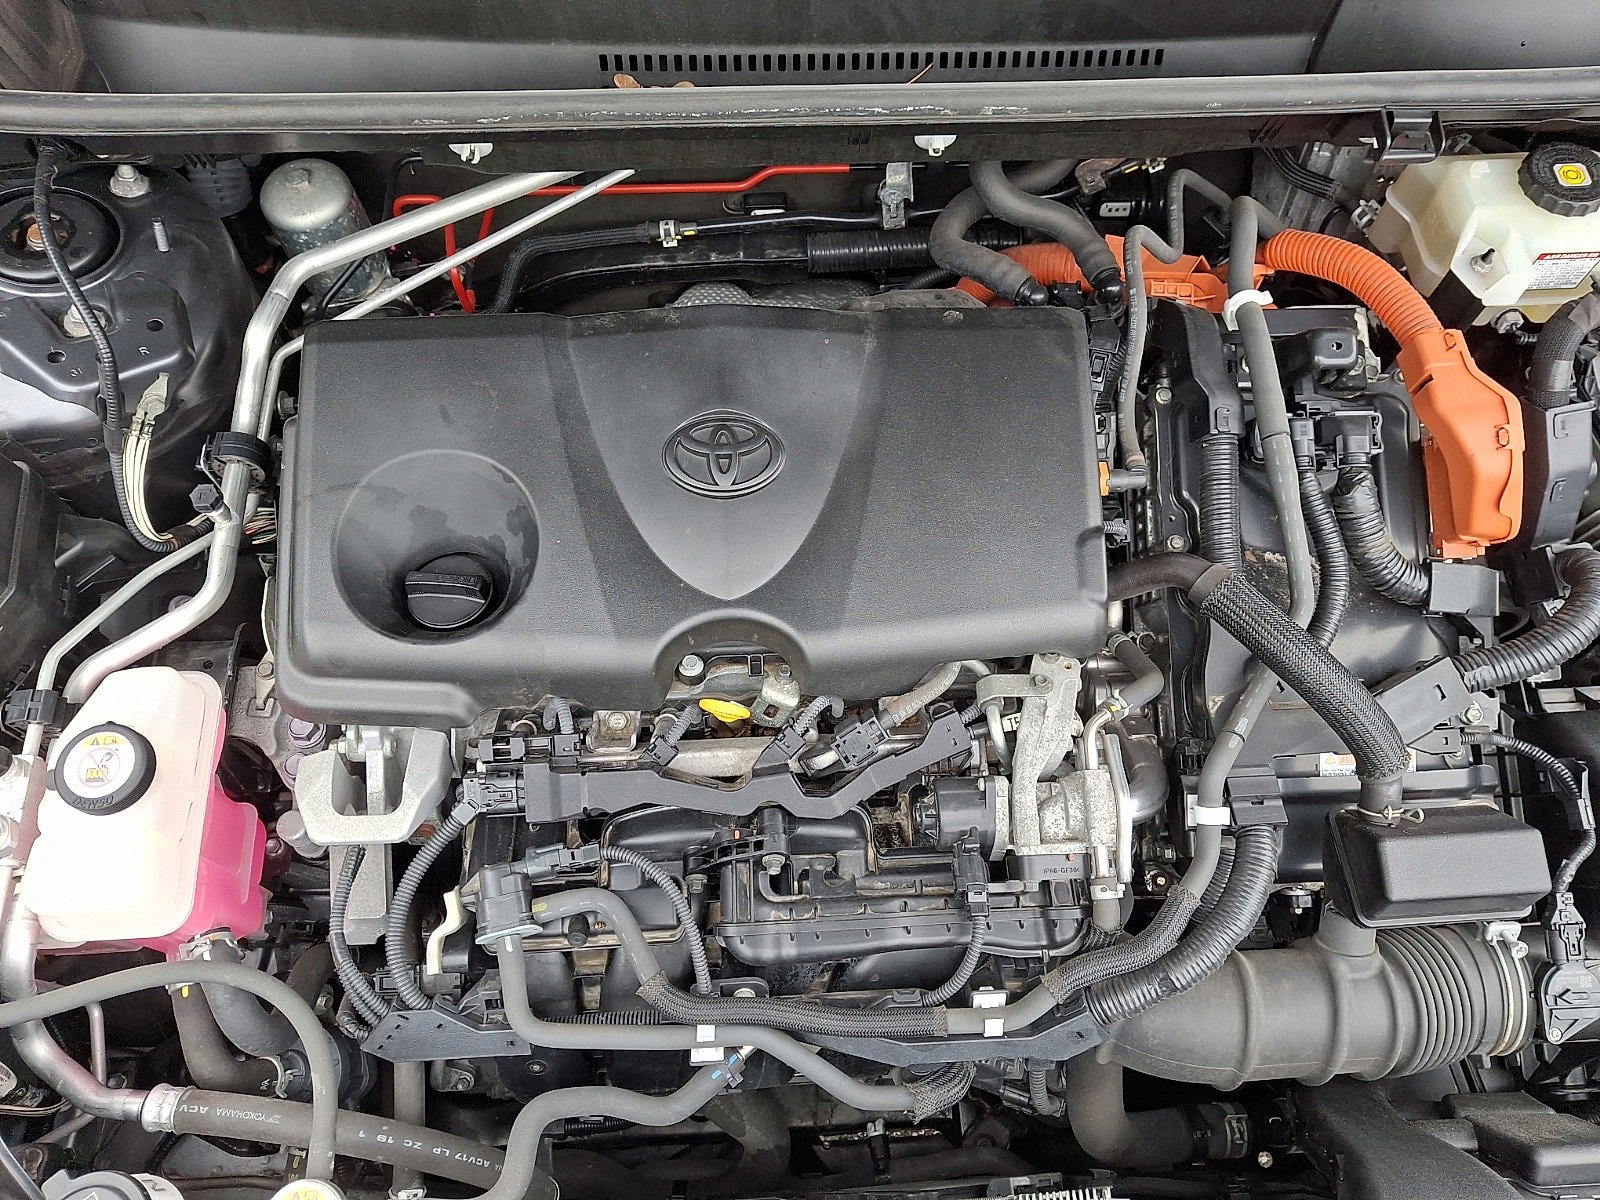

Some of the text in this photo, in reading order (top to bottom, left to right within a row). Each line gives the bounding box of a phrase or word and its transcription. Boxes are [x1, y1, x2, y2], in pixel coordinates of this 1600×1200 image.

[72, 794, 114, 809] DENSO
[176, 1104, 266, 1122] YOKOHAMA ACV
[403, 1139, 423, 1150] ZC
[432, 1146, 450, 1157] LP
[454, 1152, 490, 1167] ACV17
